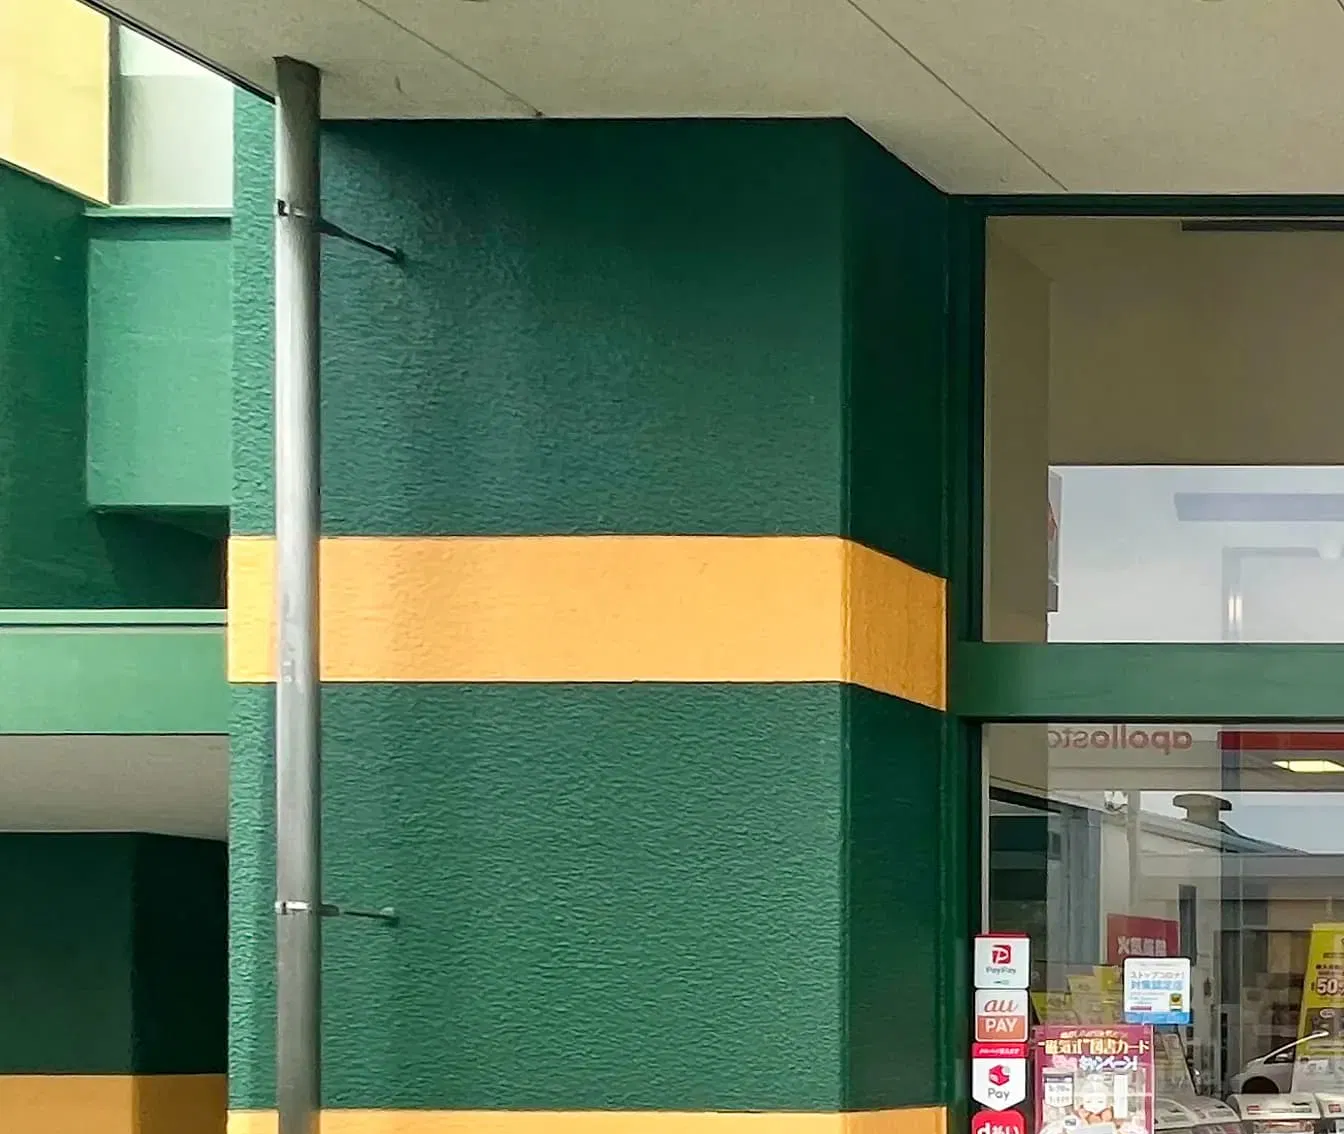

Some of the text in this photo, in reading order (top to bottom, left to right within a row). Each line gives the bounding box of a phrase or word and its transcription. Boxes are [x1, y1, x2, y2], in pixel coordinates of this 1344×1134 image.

[984, 999, 1017, 1012] au
[985, 1019, 1017, 1033] PAY
[988, 1088, 1010, 1099] Pay
